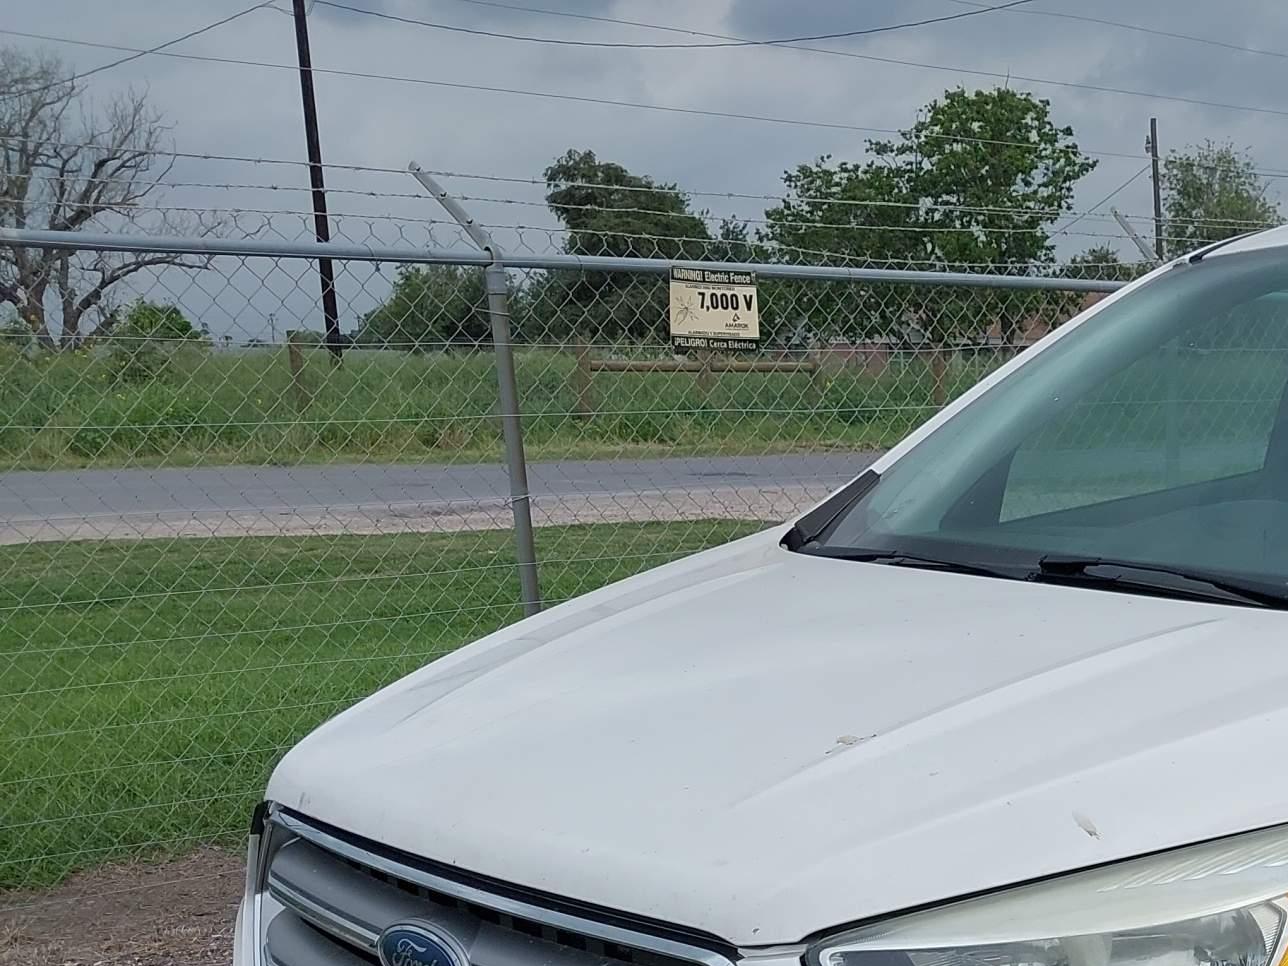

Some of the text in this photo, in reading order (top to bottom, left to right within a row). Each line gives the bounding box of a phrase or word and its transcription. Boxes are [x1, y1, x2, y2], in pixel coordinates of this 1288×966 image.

[705, 271, 729, 283] Electric
[730, 272, 751, 284] Fence
[698, 291, 753, 312] 7,000 V
[709, 339, 727, 349] Cerca
[728, 340, 757, 350] Eléctrica
